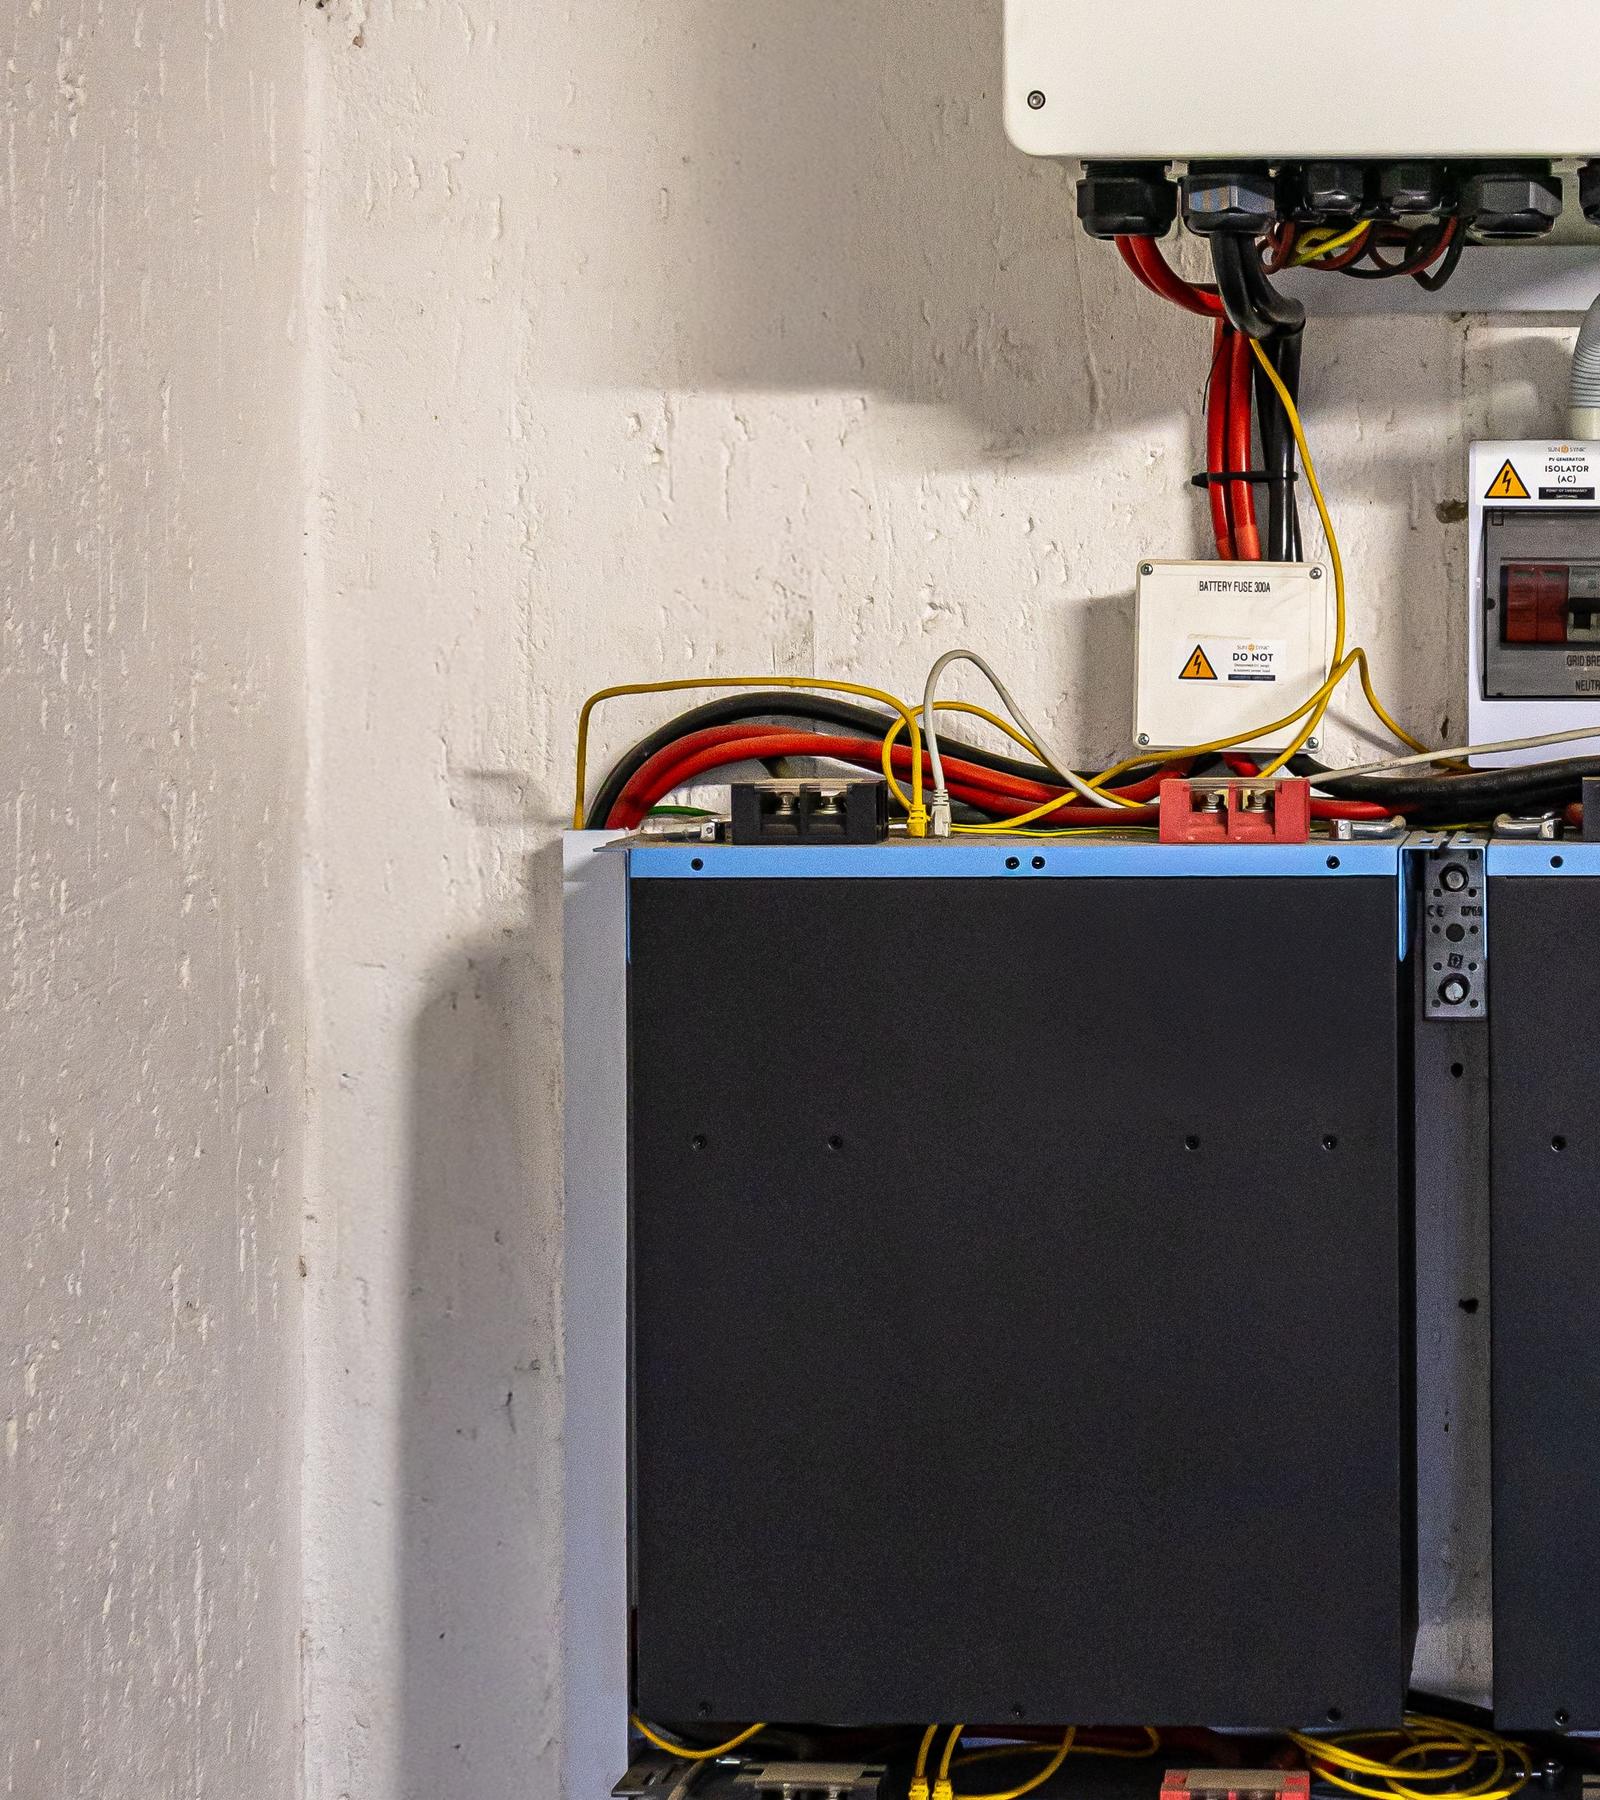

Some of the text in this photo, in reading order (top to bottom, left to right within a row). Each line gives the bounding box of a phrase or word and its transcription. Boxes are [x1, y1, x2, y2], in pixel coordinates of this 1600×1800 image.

[1544, 465, 1589, 473] ISOLATOR
[1557, 475, 1577, 484] (AC)
[1199, 580, 1271, 593] BATTERY FUSE 300A
[1232, 652, 1274, 662] DO NOT
[1566, 654, 1585, 667] GRID
